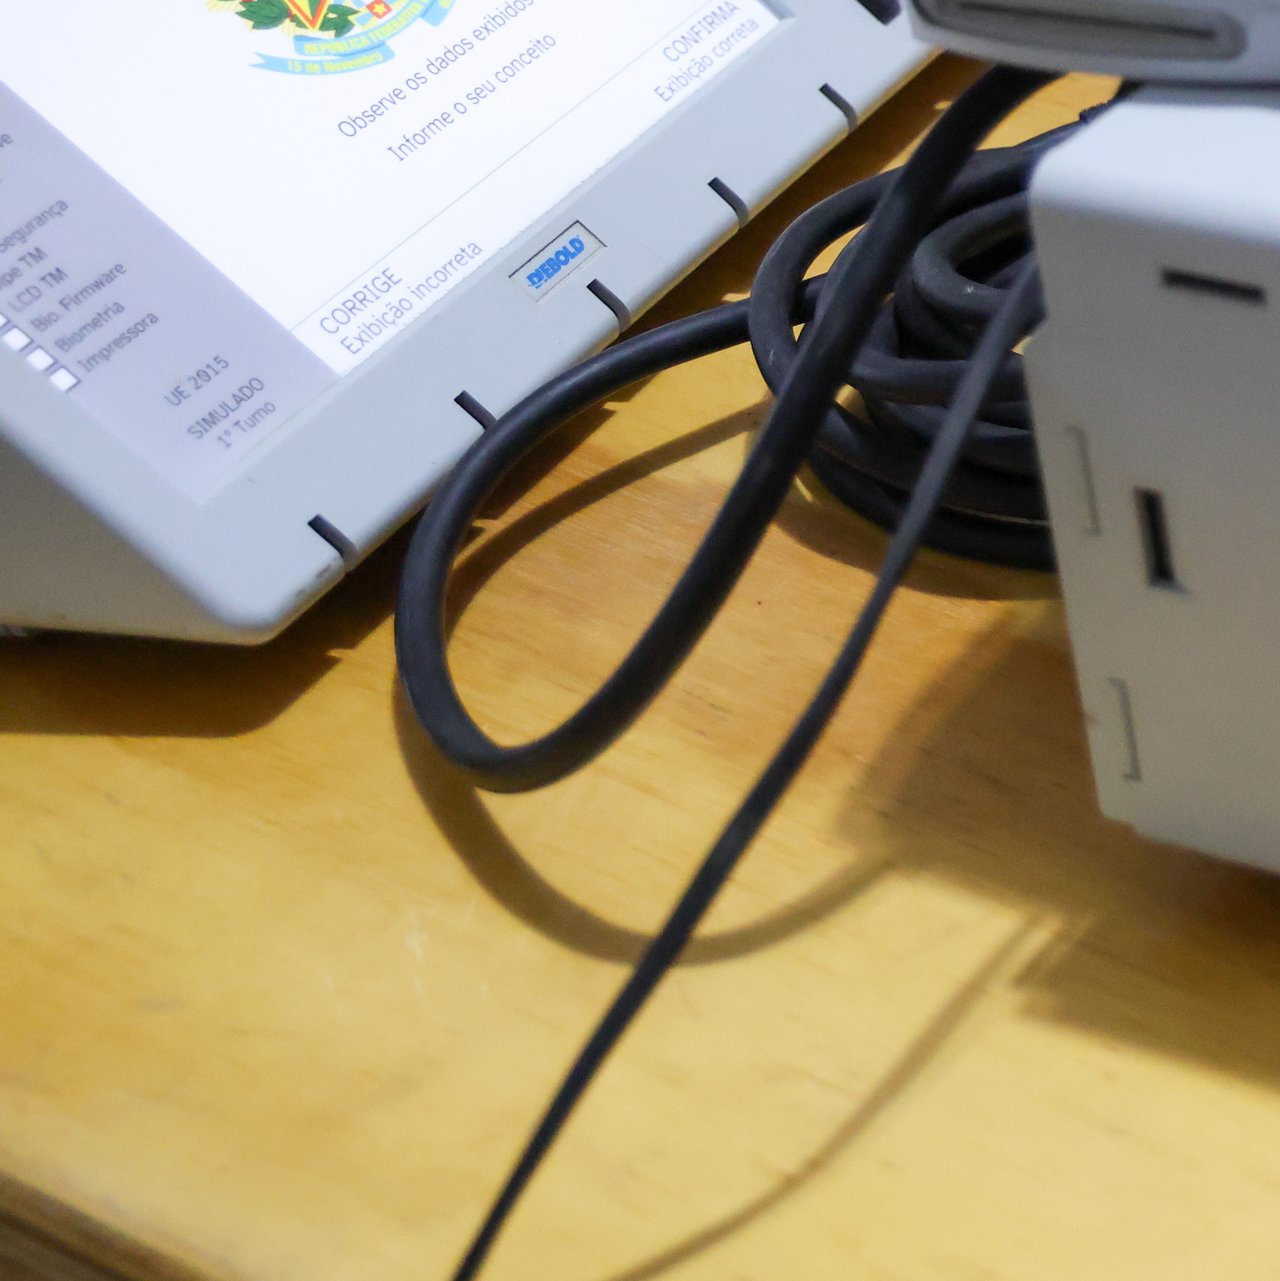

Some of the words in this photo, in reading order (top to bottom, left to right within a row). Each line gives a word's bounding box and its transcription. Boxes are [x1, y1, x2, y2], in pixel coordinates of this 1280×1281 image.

[653, 55, 713, 102] Exibição
[712, 18, 759, 58] correta
[663, 1, 741, 62] CONFIRMA
[337, 87, 407, 138] Observe
[405, 71, 428, 91] os
[426, 36, 475, 76] dados
[387, 111, 454, 162] Informe
[453, 101, 468, 114] o
[466, 79, 496, 105] seu
[494, 34, 556, 84] conceito
[40, 267, 69, 290] TM
[58, 263, 127, 312] Firmware
[320, 267, 403, 335] CORRIGE
[340, 296, 413, 356] Exibição
[410, 242, 483, 301] incorreta
[54, 300, 125, 353] Biometria
[77, 312, 159, 373] Impressora
[165, 384, 191, 407] UE
[187, 355, 230, 391] 2015
[187, 377, 265, 440] SIMULADO
[232, 401, 277, 434] Turno
